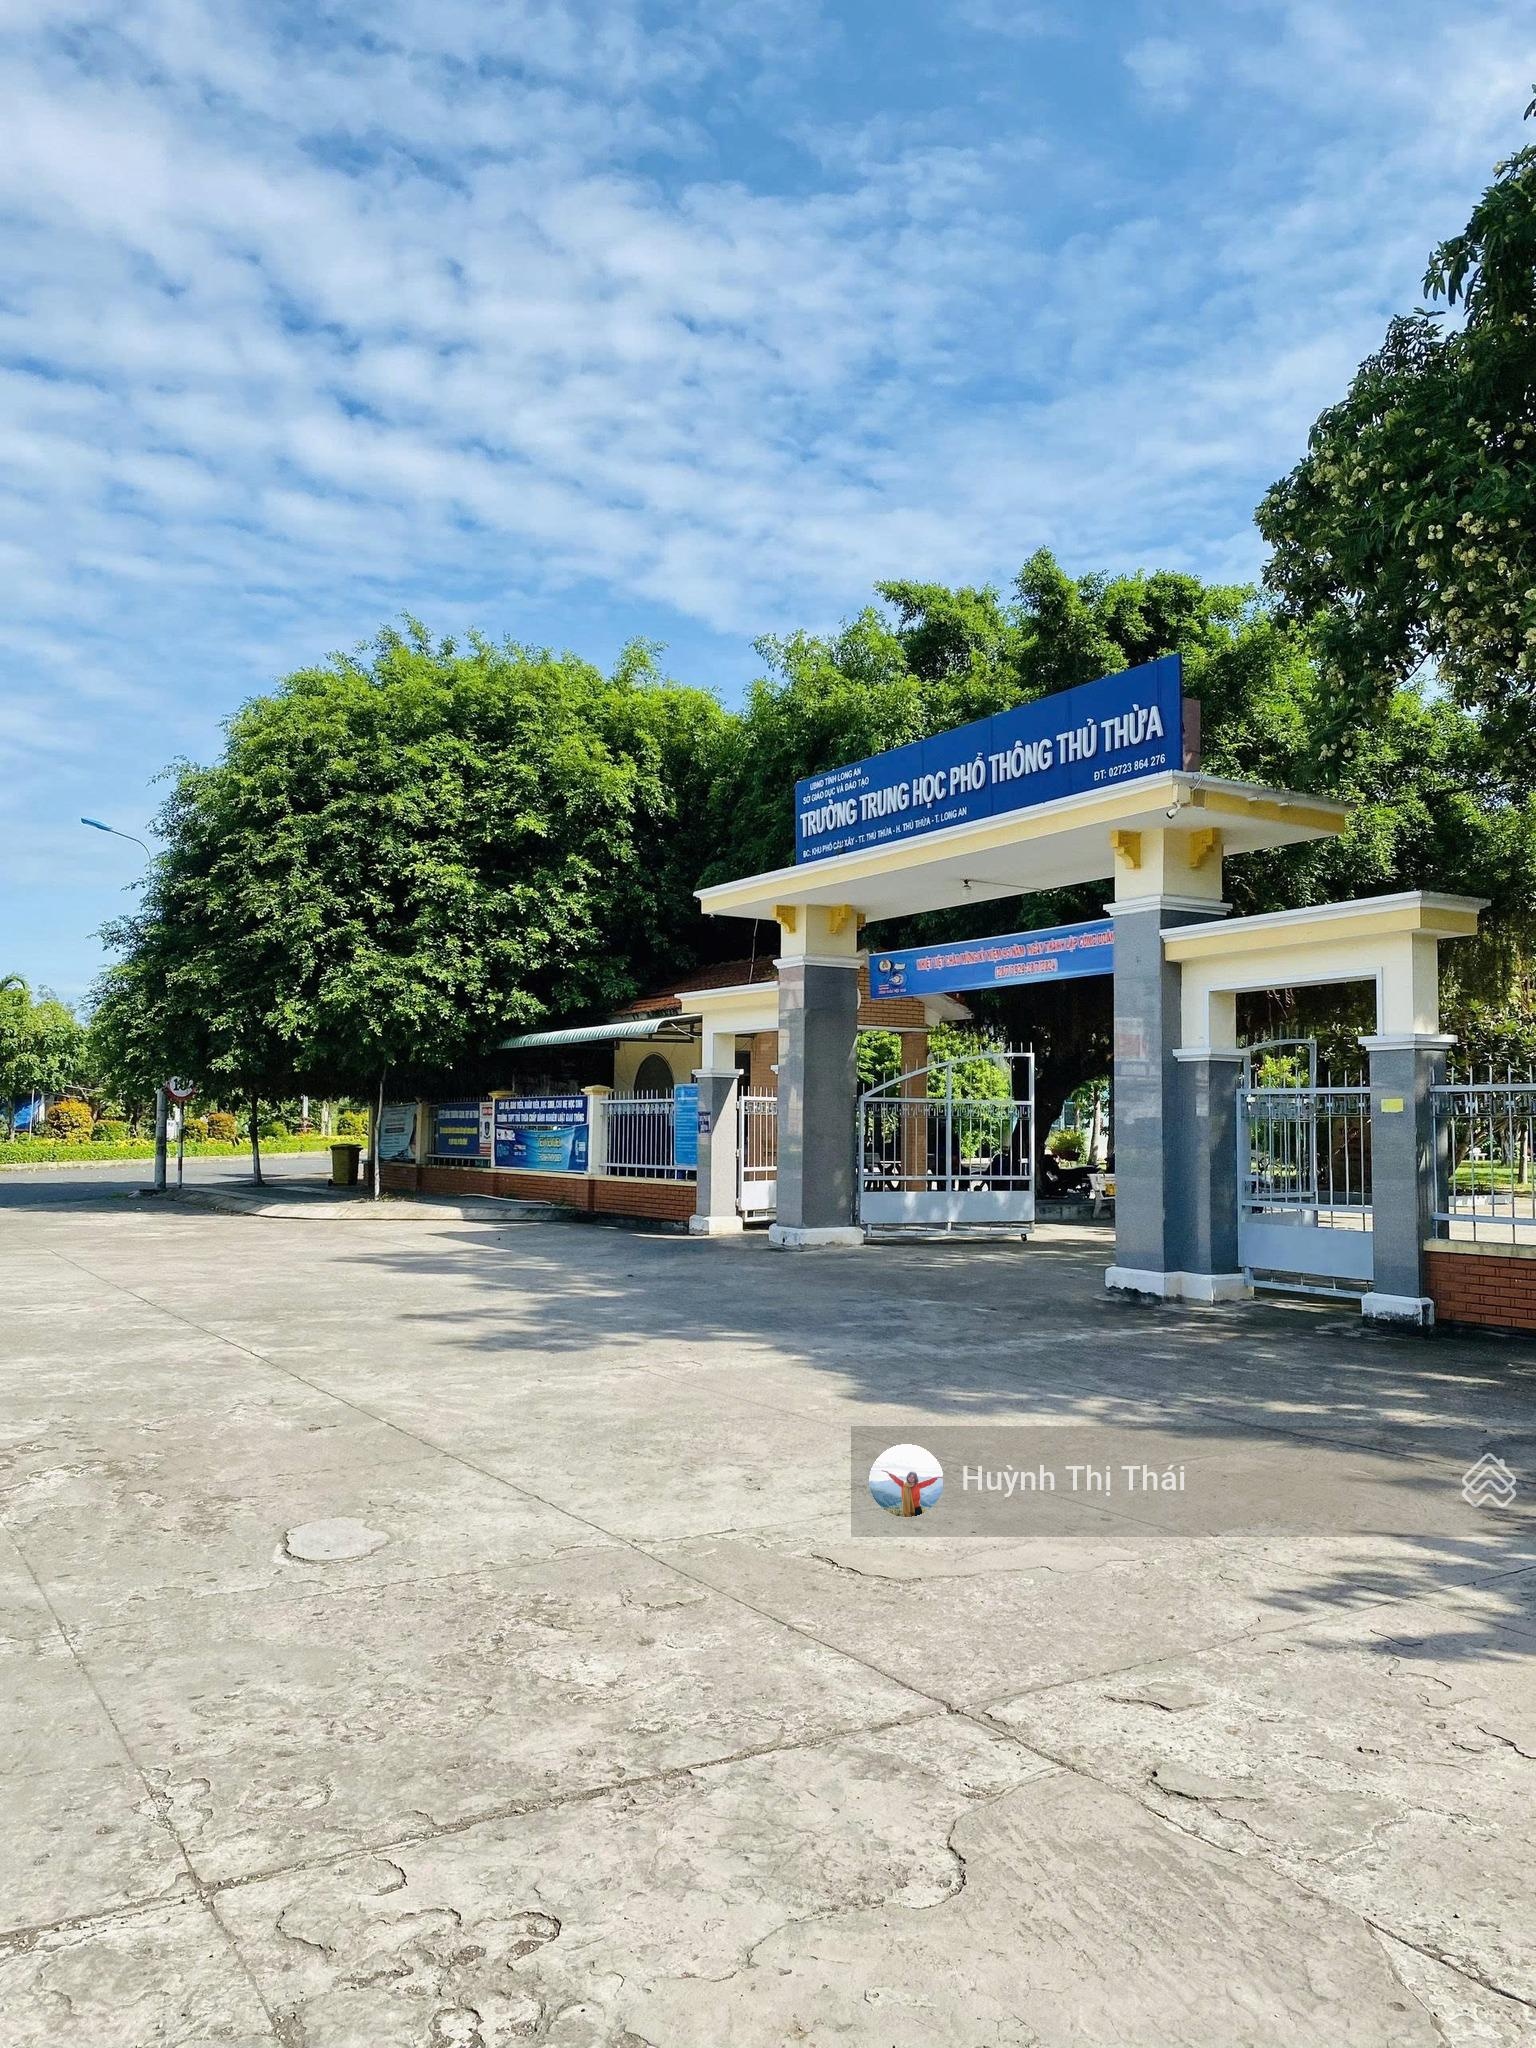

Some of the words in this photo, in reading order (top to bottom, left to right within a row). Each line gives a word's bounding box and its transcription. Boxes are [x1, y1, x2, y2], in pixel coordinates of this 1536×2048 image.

[800, 798, 858, 838] TRƯỜNG
[859, 783, 910, 821] TRUNG
[912, 771, 947, 809] HỌC
[949, 752, 987, 796] PHỔ
[988, 740, 1053, 784] THÔNG
[1056, 718, 1098, 764] THỦ
[1101, 704, 1165, 753] THỪA
[809, 778, 825, 790] UBND
[837, 770, 853, 781] LONG
[853, 767, 862, 776] AN
[1093, 769, 1107, 782] ĐT:
[1108, 761, 1133, 778] 02723
[1134, 757, 1150, 771] 864
[1150, 753, 1166, 767] 276
[810, 788, 825, 803] GIÁO
[823, 785, 837, 799] DỤC
[836, 780, 845, 794] VÀ
[856, 776, 870, 790] TẠO
[811, 844, 822, 856] KHU
[902, 820, 914, 834] THỦ
[915, 816, 932, 830] THỪA
[935, 814, 940, 823] T.
[940, 808, 957, 822] LONG
[957, 806, 968, 817] AN
